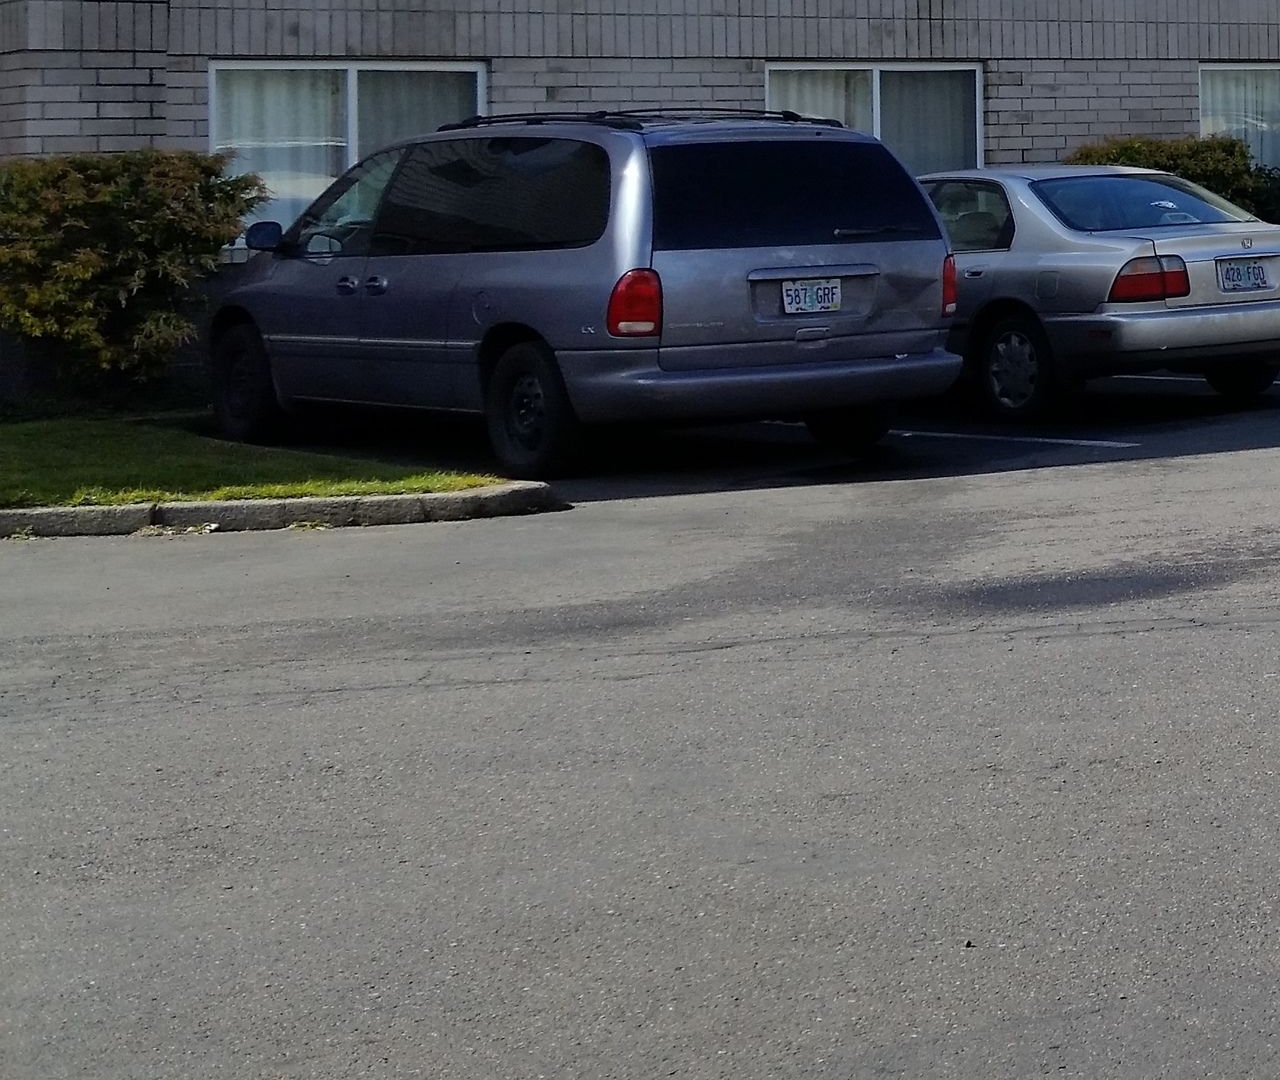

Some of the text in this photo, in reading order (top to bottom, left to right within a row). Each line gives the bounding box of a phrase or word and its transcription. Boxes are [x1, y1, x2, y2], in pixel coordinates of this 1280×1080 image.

[1225, 267, 1242, 282] 428
[785, 286, 838, 305] 587 GRF
